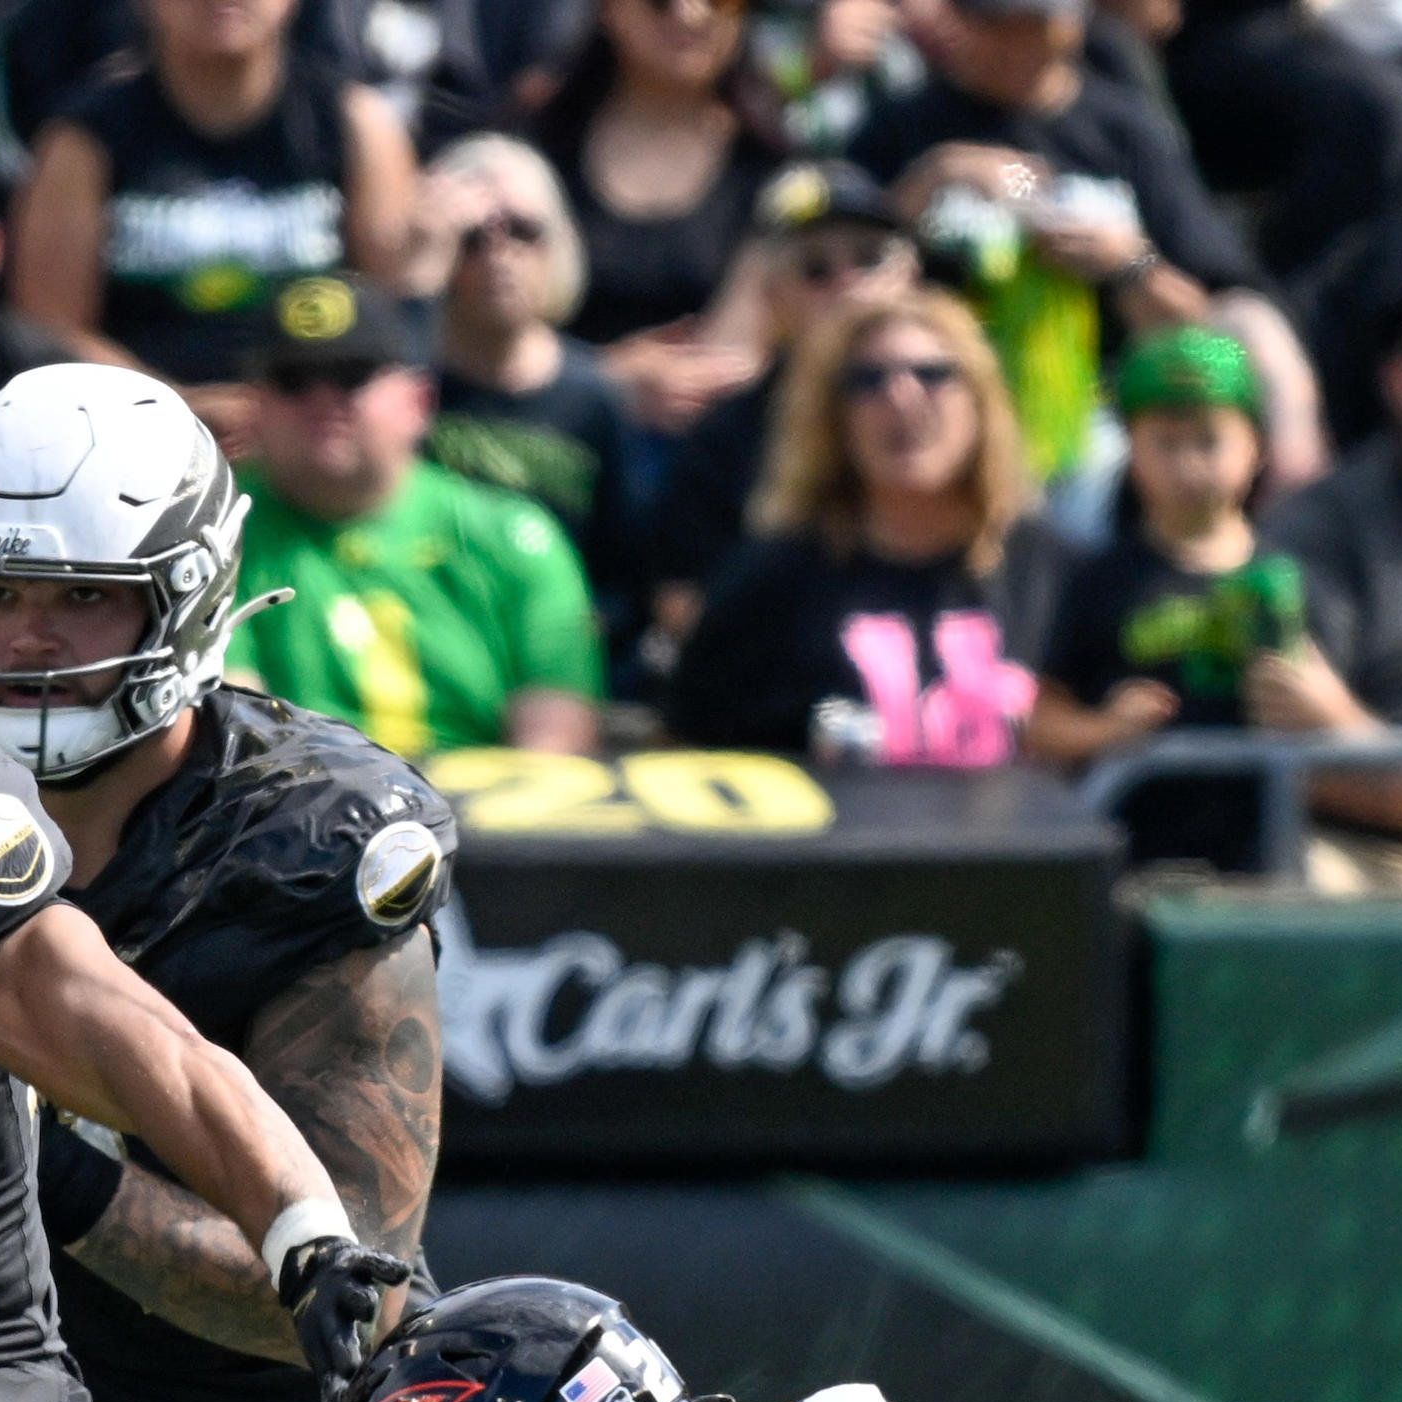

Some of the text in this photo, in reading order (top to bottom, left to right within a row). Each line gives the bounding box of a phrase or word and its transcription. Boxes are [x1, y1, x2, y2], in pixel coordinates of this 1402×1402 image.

[424, 746, 836, 838] 20
[506, 930, 992, 1088] Carl's Jr.
